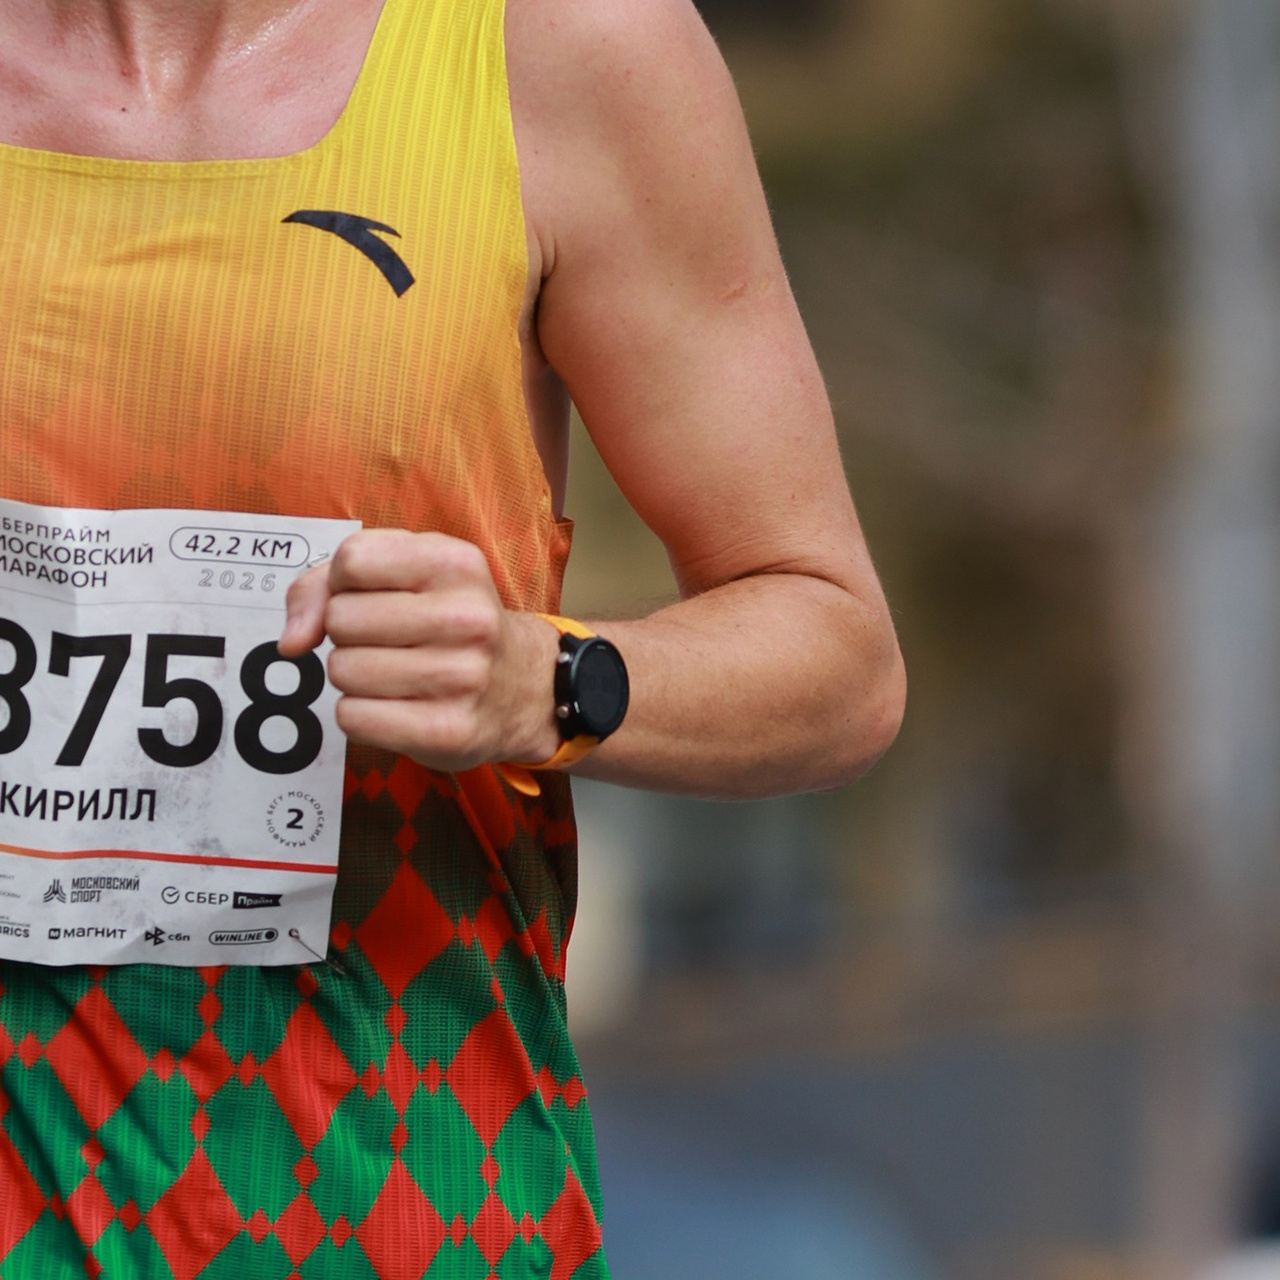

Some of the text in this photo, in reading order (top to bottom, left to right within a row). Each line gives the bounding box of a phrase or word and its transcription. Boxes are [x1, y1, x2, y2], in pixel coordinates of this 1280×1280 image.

[184, 534, 241, 557] 42,2
[198, 568, 277, 592] 2026
[0, 781, 156, 822] КИРИЛЛ
[286, 808, 304, 830] 2
[71, 876, 140, 891] МОСКОВСКИЙ
[71, 890, 102, 903] СПОРТ
[184, 891, 229, 905] СБЕР
[214, 932, 263, 942] WINLINE
